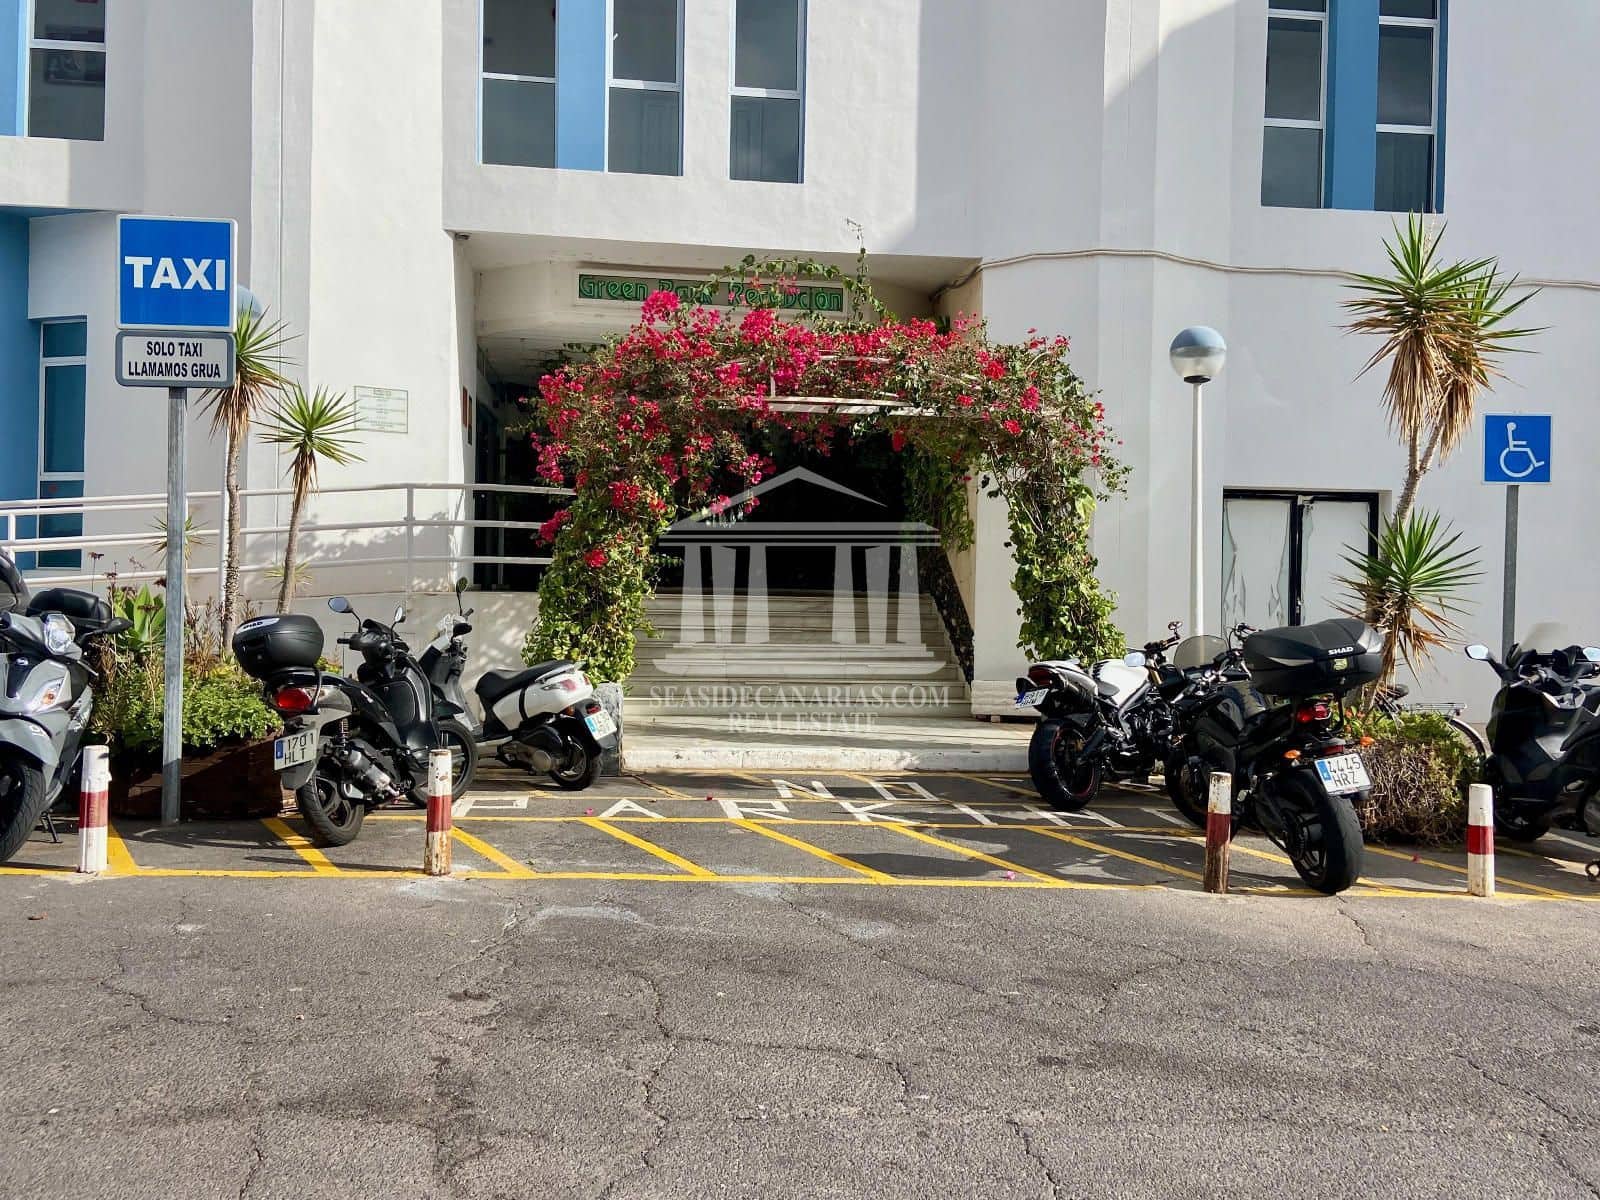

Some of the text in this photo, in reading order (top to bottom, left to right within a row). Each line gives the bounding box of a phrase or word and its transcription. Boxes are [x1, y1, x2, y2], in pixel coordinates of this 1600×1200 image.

[124, 256, 226, 291] TAXI
[579, 275, 649, 302] Green
[146, 340, 203, 357] SOLO TAXI
[128, 361, 221, 378] LLAMAMOS GRUA
[1328, 646, 1354, 656] SHAD
[287, 732, 314, 751] 1701
[1327, 756, 1361, 774] 4445
[1332, 771, 1360, 787] HRZ
